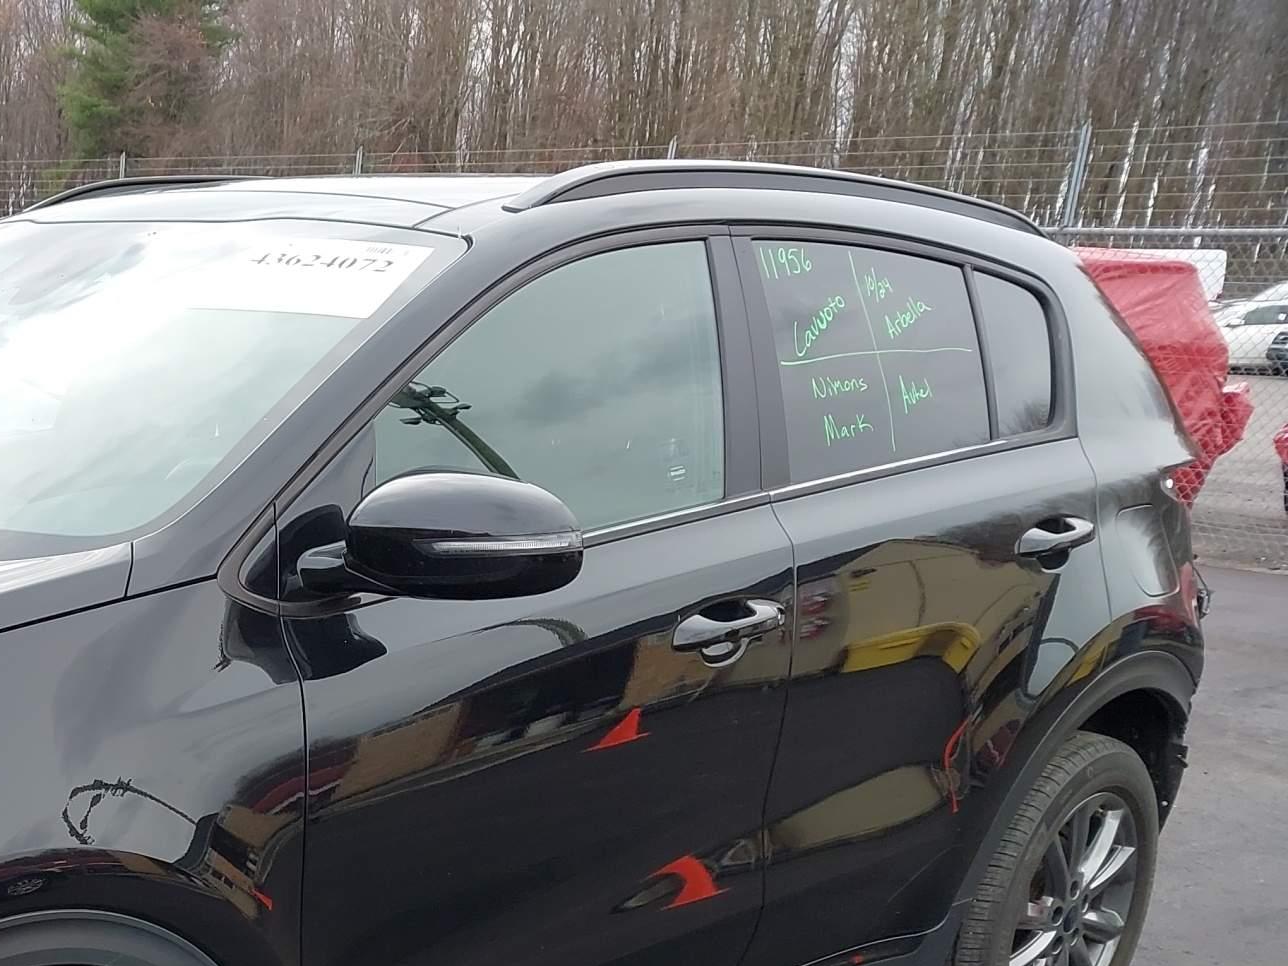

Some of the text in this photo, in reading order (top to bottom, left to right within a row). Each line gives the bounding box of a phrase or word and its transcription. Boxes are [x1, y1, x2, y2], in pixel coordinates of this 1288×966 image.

[250, 252, 394, 272] 43624072
[760, 247, 812, 280] 11956
[884, 297, 932, 340] Arbella
[823, 414, 874, 447] Mark
